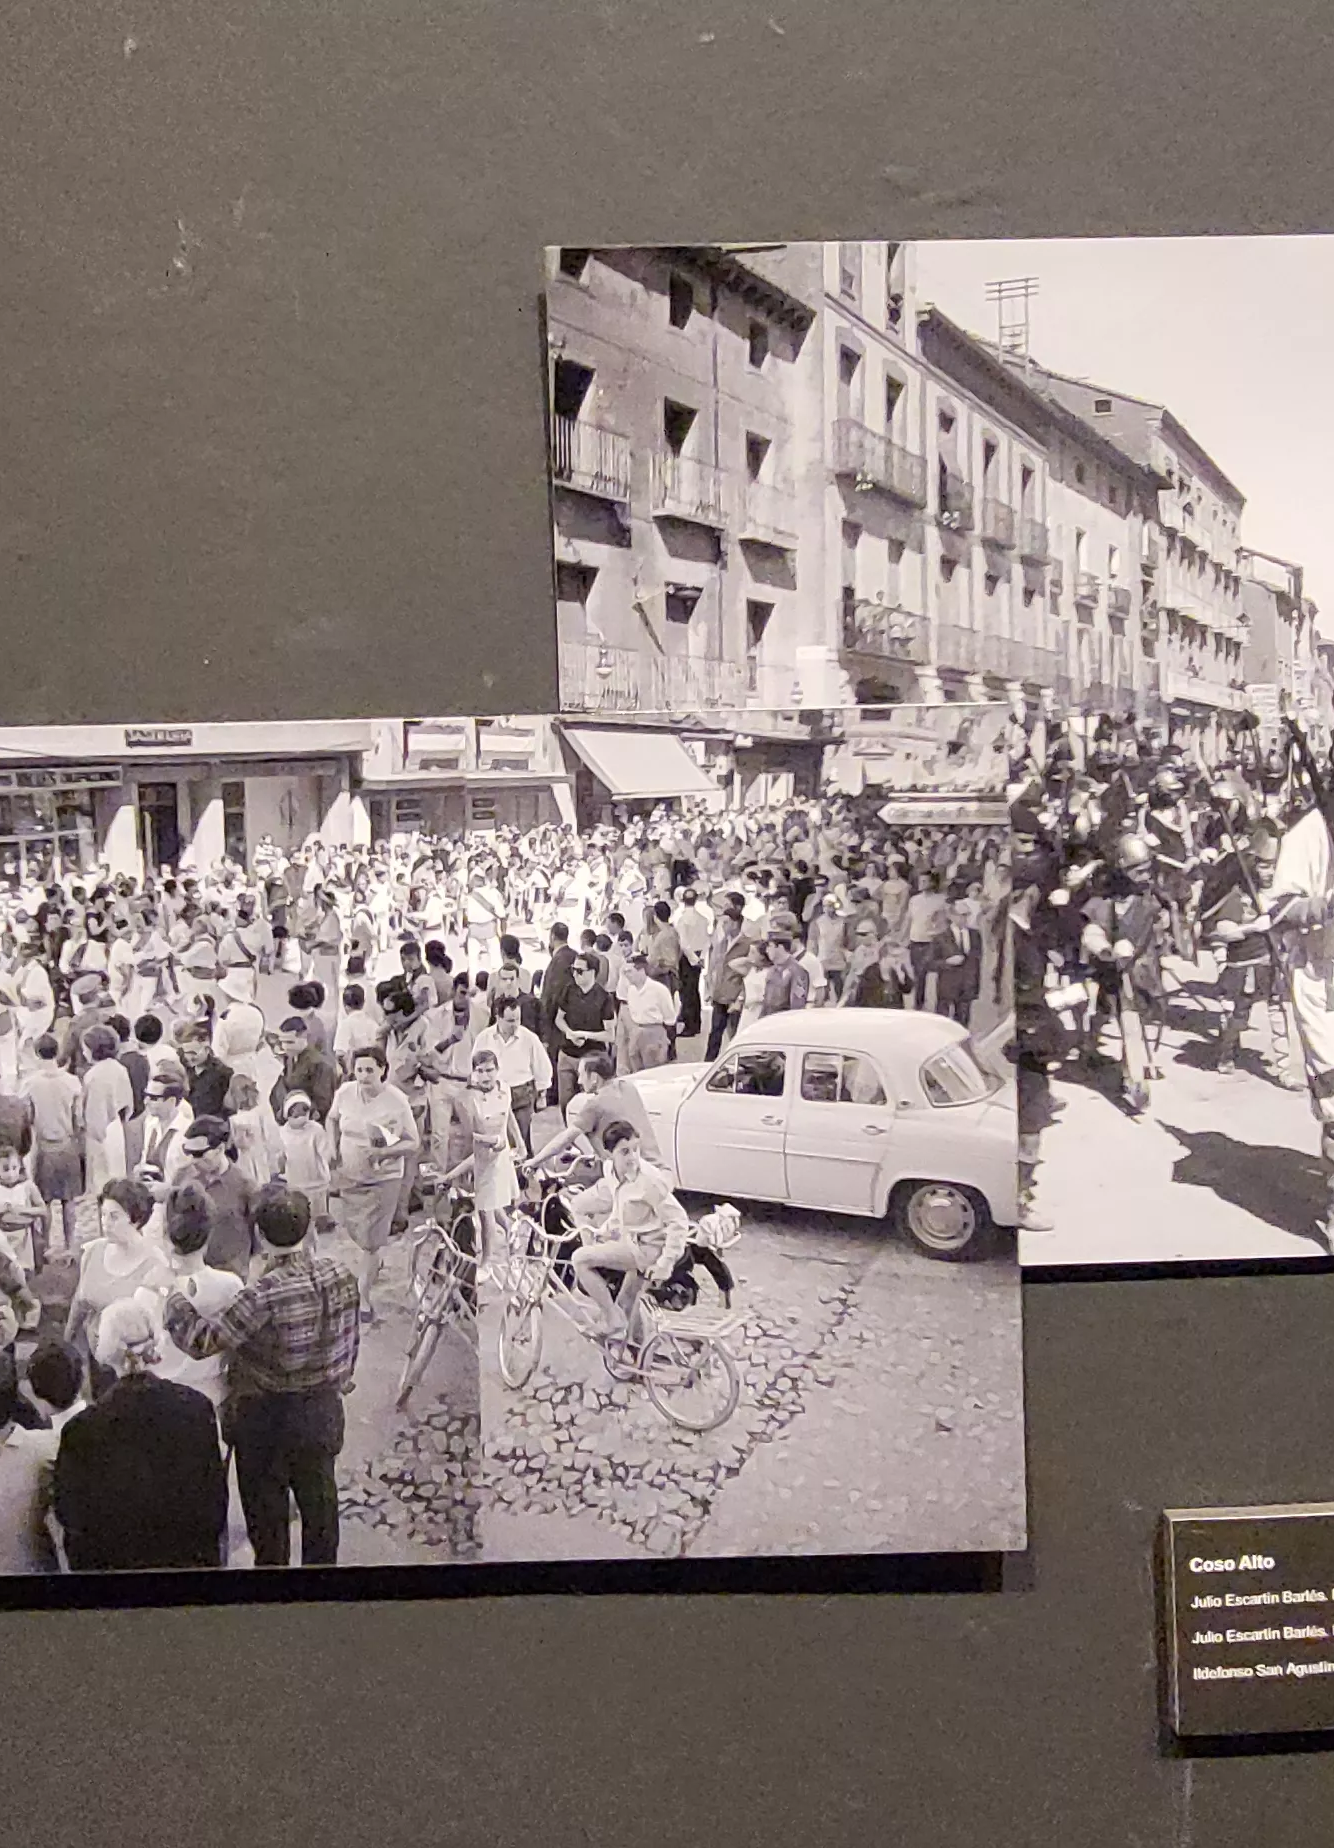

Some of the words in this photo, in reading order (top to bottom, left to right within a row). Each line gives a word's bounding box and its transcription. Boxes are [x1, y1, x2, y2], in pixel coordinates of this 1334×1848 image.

[1189, 1557, 1236, 1573] Coso
[1238, 1554, 1276, 1570] Alto
[1190, 1595, 1222, 1609] Julio
[1191, 1630, 1223, 1645] Julio
[1193, 1665, 1254, 1680] Ildefonso
[1254, 1663, 1283, 1677] San
